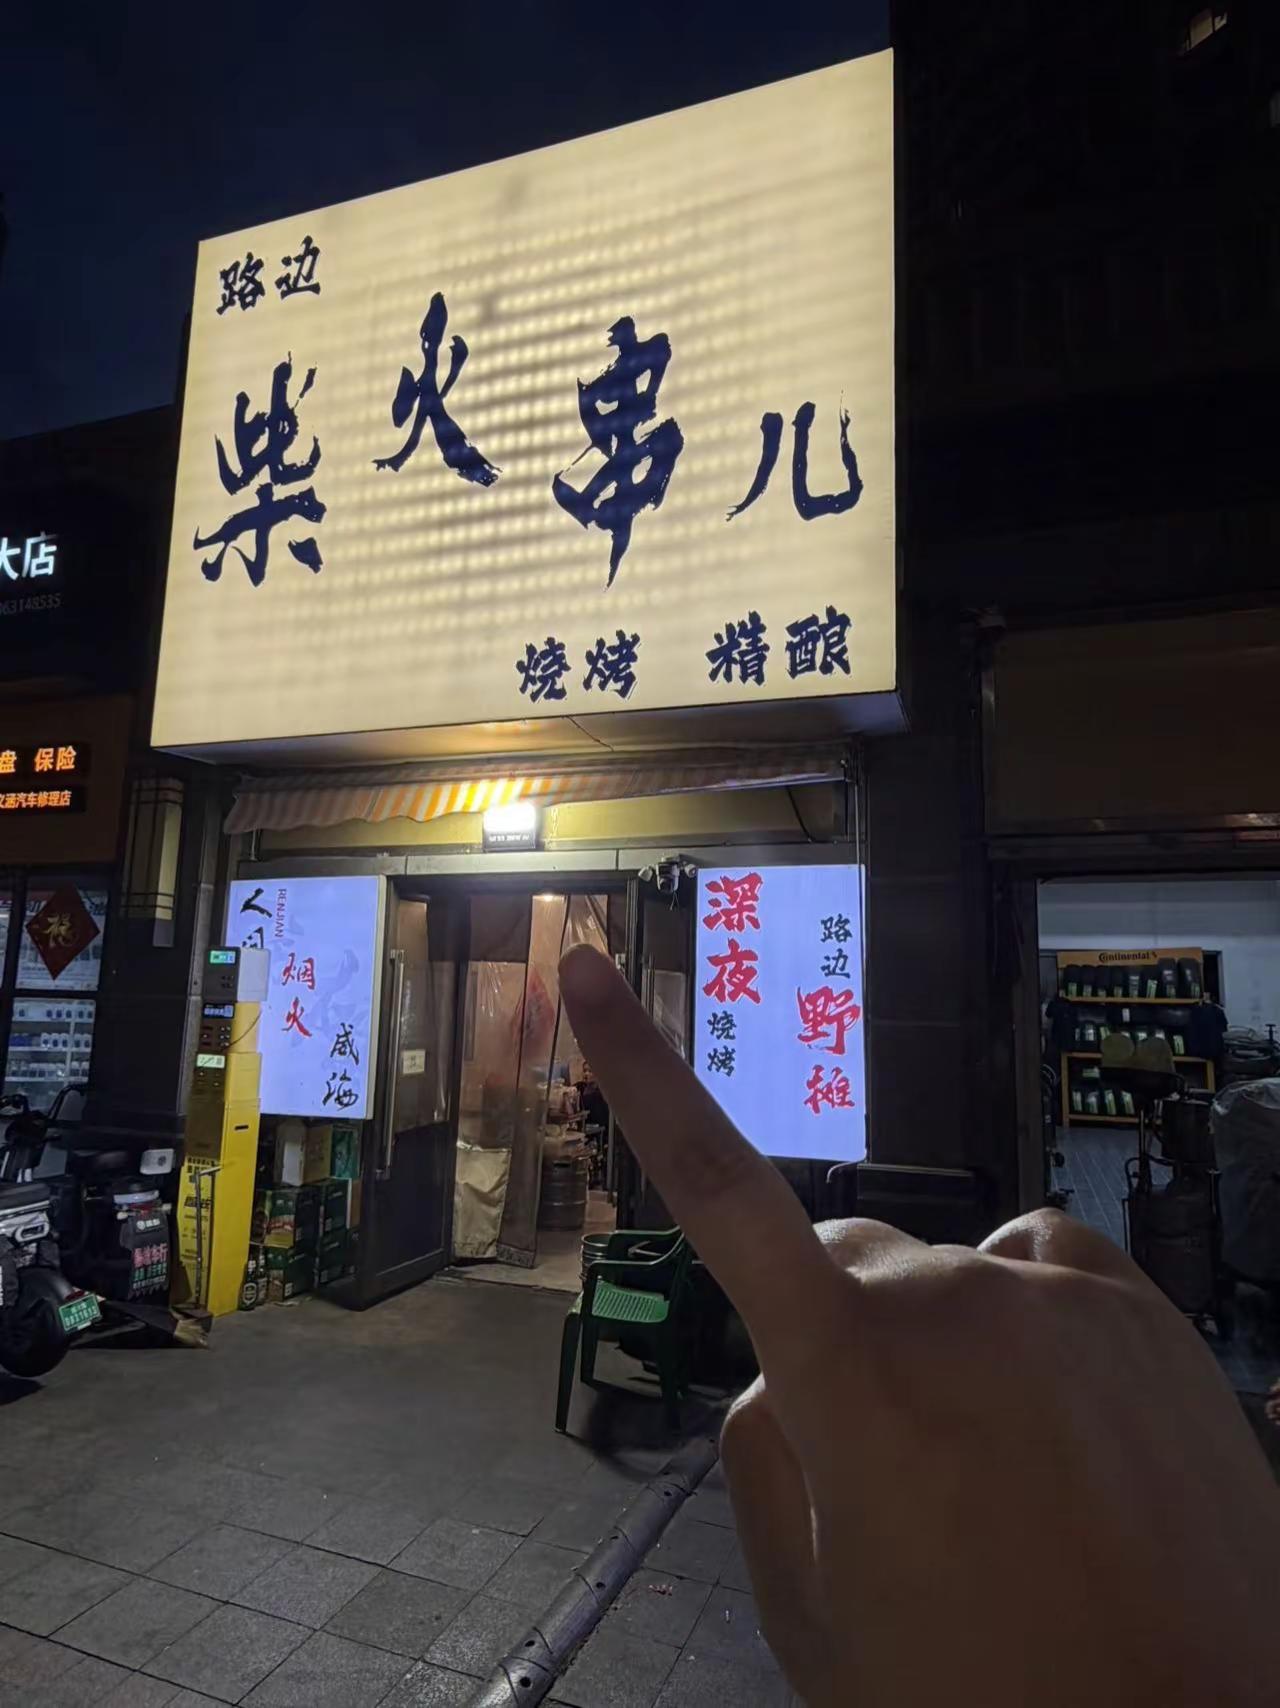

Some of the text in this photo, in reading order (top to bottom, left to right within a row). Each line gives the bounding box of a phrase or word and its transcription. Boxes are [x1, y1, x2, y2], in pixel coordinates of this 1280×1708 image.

[216, 235, 320, 315] 路边
[194, 292, 863, 589] 柴火串儿
[516, 605, 852, 702] 烧烤 精酿
[34, 745, 77, 772] 保险
[275, 888, 287, 938] RENJIAN
[281, 953, 316, 1038] 烟火
[702, 872, 763, 1077] 深夜 烧烤
[1098, 951, 1150, 964] Continental
[797, 913, 862, 1115] 路边 野摊
[322, 1022, 360, 1111] 威海
